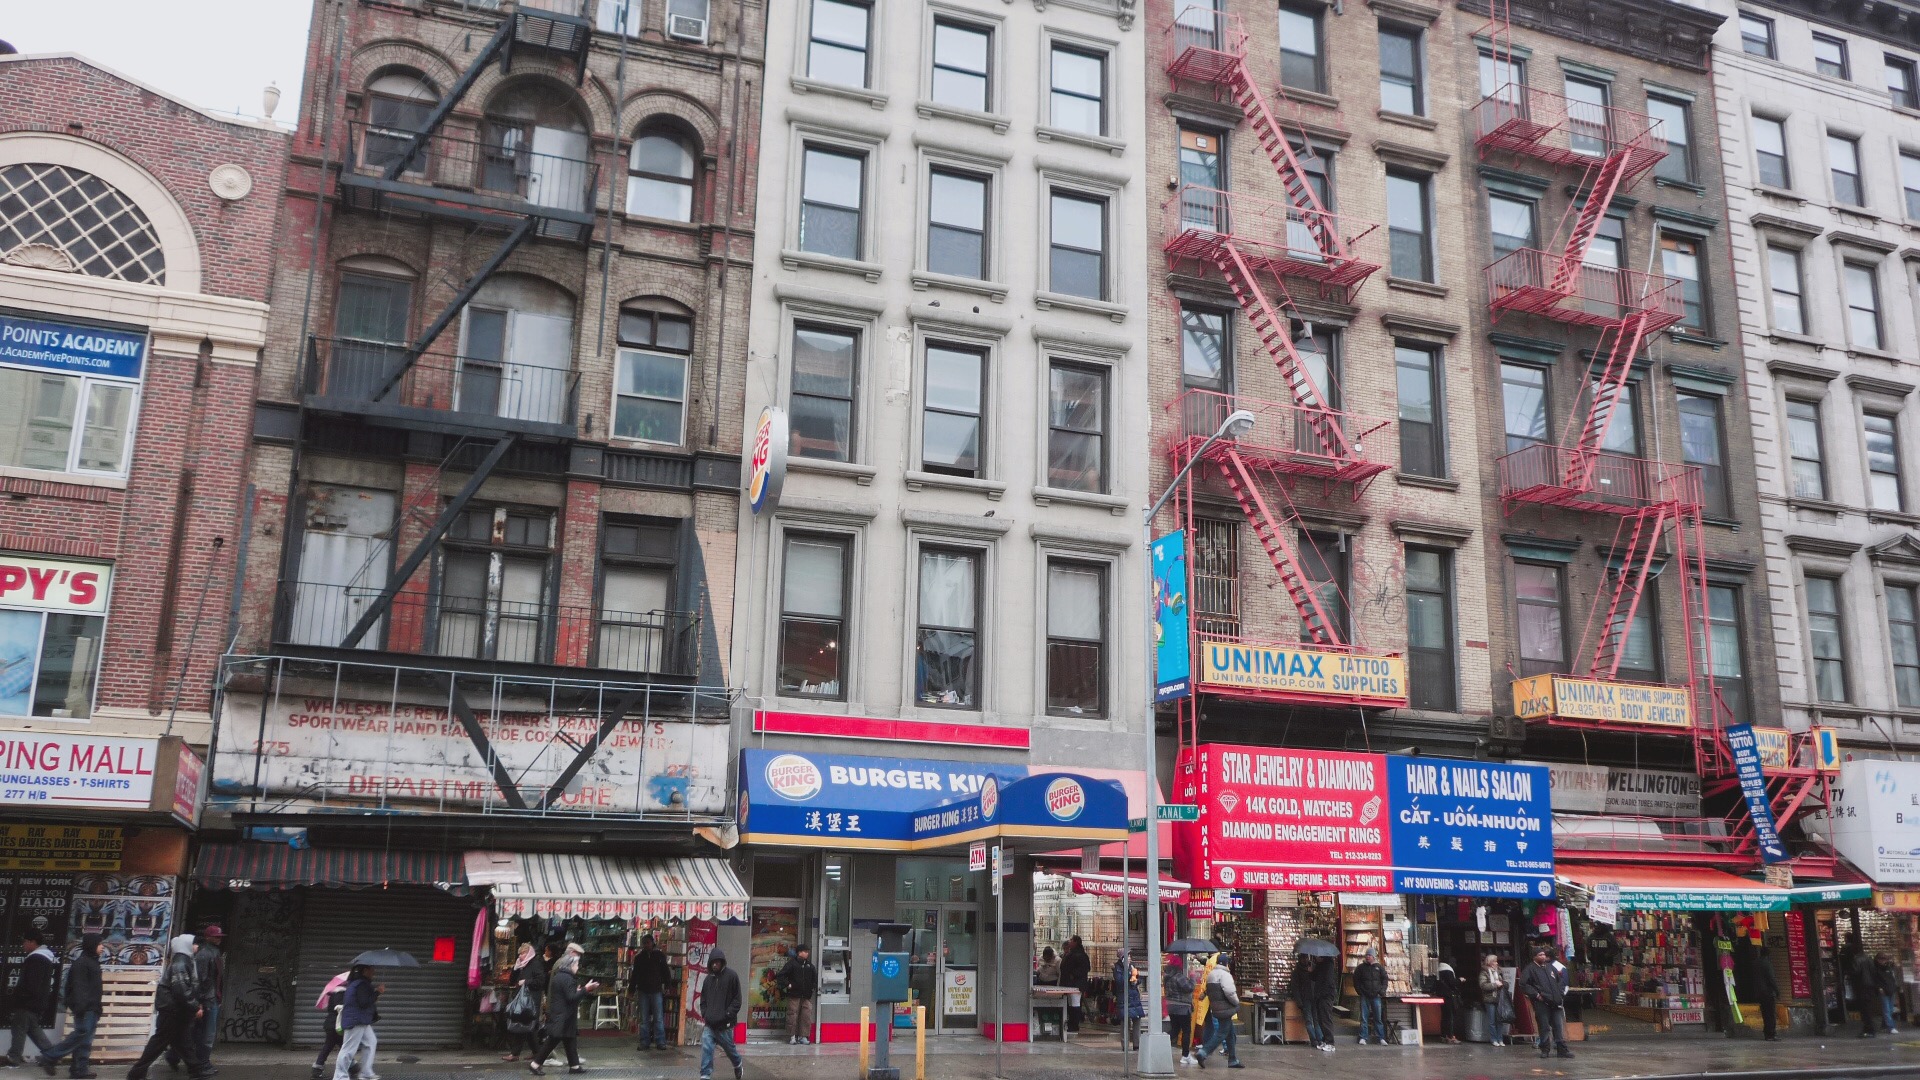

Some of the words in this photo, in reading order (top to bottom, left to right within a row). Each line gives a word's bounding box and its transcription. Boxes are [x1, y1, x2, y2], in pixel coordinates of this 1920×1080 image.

[2, 325, 59, 347] POINTS
[61, 334, 139, 357] ACADEMY
[1212, 646, 1324, 678] UNIMAX
[1338, 657, 1389, 676] TATTOO
[1212, 672, 1325, 689] UNIMAXSHOP.COM
[1332, 674, 1398, 694] SUPPLIES
[1530, 680, 1537, 694] 7
[1158, 683, 1185, 696] nycgo.com
[1557, 682, 1615, 705] UNIMAX
[1620, 688, 1651, 703] PIERCING
[1653, 692, 1685, 706] SUPPLIES
[305, 699, 401, 717] WHOLESALE
[1521, 696, 1549, 715] DAYS
[1621, 702, 1643, 720] BODY
[1647, 706, 1686, 723] JEWELRY
[289, 714, 388, 733] SPORTWEAR
[394, 722, 437, 736] HAND
[252, 740, 290, 756] 275
[1729, 736, 1753, 749] TATTOO
[68, 744, 152, 776] MALL
[771, 765, 813, 777] BURGER
[829, 765, 942, 791] BURGER
[1222, 752, 1251, 784] STAR
[1253, 755, 1304, 787] JEWELRY
[1307, 759, 1315, 788] &
[1318, 761, 1375, 791] DIAMONDS
[80, 778, 130, 789] T-SHIRTS
[773, 774, 815, 789] KING
[1406, 764, 1438, 795] HAIR
[1440, 766, 1450, 796] &
[1452, 767, 1489, 799] NAILS
[1491, 770, 1532, 801] SALON
[1608, 772, 1687, 795] WELLINGTON
[4, 789, 25, 799] 277
[28, 791, 47, 801] H/B
[1049, 785, 1079, 800] BURGER
[1051, 792, 1081, 812] KING
[1246, 796, 1267, 814] 14K
[1269, 798, 1301, 819] GOLD,
[1303, 800, 1353, 818] WATCHES
[1157, 806, 1183, 819] CANAL
[805, 811, 861, 832] 漢堡王
[914, 815, 940, 833] BURGER
[941, 809, 960, 828] KING
[28, 827, 45, 837] RAY
[64, 828, 80, 838] RAY
[98, 829, 115, 839] RAY
[1222, 821, 1272, 840] DIAMOND
[1275, 824, 1346, 843] ENGAGEMENT
[1349, 827, 1381, 844] RINGS
[18, 837, 52, 848] DAVIES
[54, 838, 87, 849] DAVIES
[89, 839, 122, 850] DAVIES
[970, 848, 984, 865] ATM
[1506, 860, 1518, 868] TEL:
[20, 878, 42, 886] NEW
[45, 878, 72, 886] YORK
[229, 879, 251, 888] 275
[1223, 871, 1233, 879] 271
[1243, 872, 1269, 884] SILVER
[1271, 872, 1284, 885] 925
[1289, 873, 1323, 886] PERFUME
[1328, 874, 1350, 887] BELTS
[1356, 875, 1386, 887] T-SHIRTS
[1404, 877, 1415, 888] NY
[1415, 878, 1454, 890] SOUVENIRS
[1459, 880, 1489, 892] SCARVES
[1494, 882, 1528, 893] LUGGAGES
[1541, 883, 1551, 892] 271
[45, 890, 67, 898] YOU
[1080, 880, 1100, 891] LUCKY
[1101, 883, 1125, 893] CHARMS
[1158, 889, 1181, 898] EWELRY
[1822, 892, 1841, 900] 269A
[20, 897, 66, 908] HARD
[503, 902, 525, 913] 275
[536, 902, 572, 913] GOOD
[576, 902, 636, 914] DISCOUNT
[641, 903, 686, 914] CENTER
[690, 903, 711, 914] INC.
[34, 908, 65, 917] SOFT?
[1671, 1012, 1703, 1022] PERFUMES
